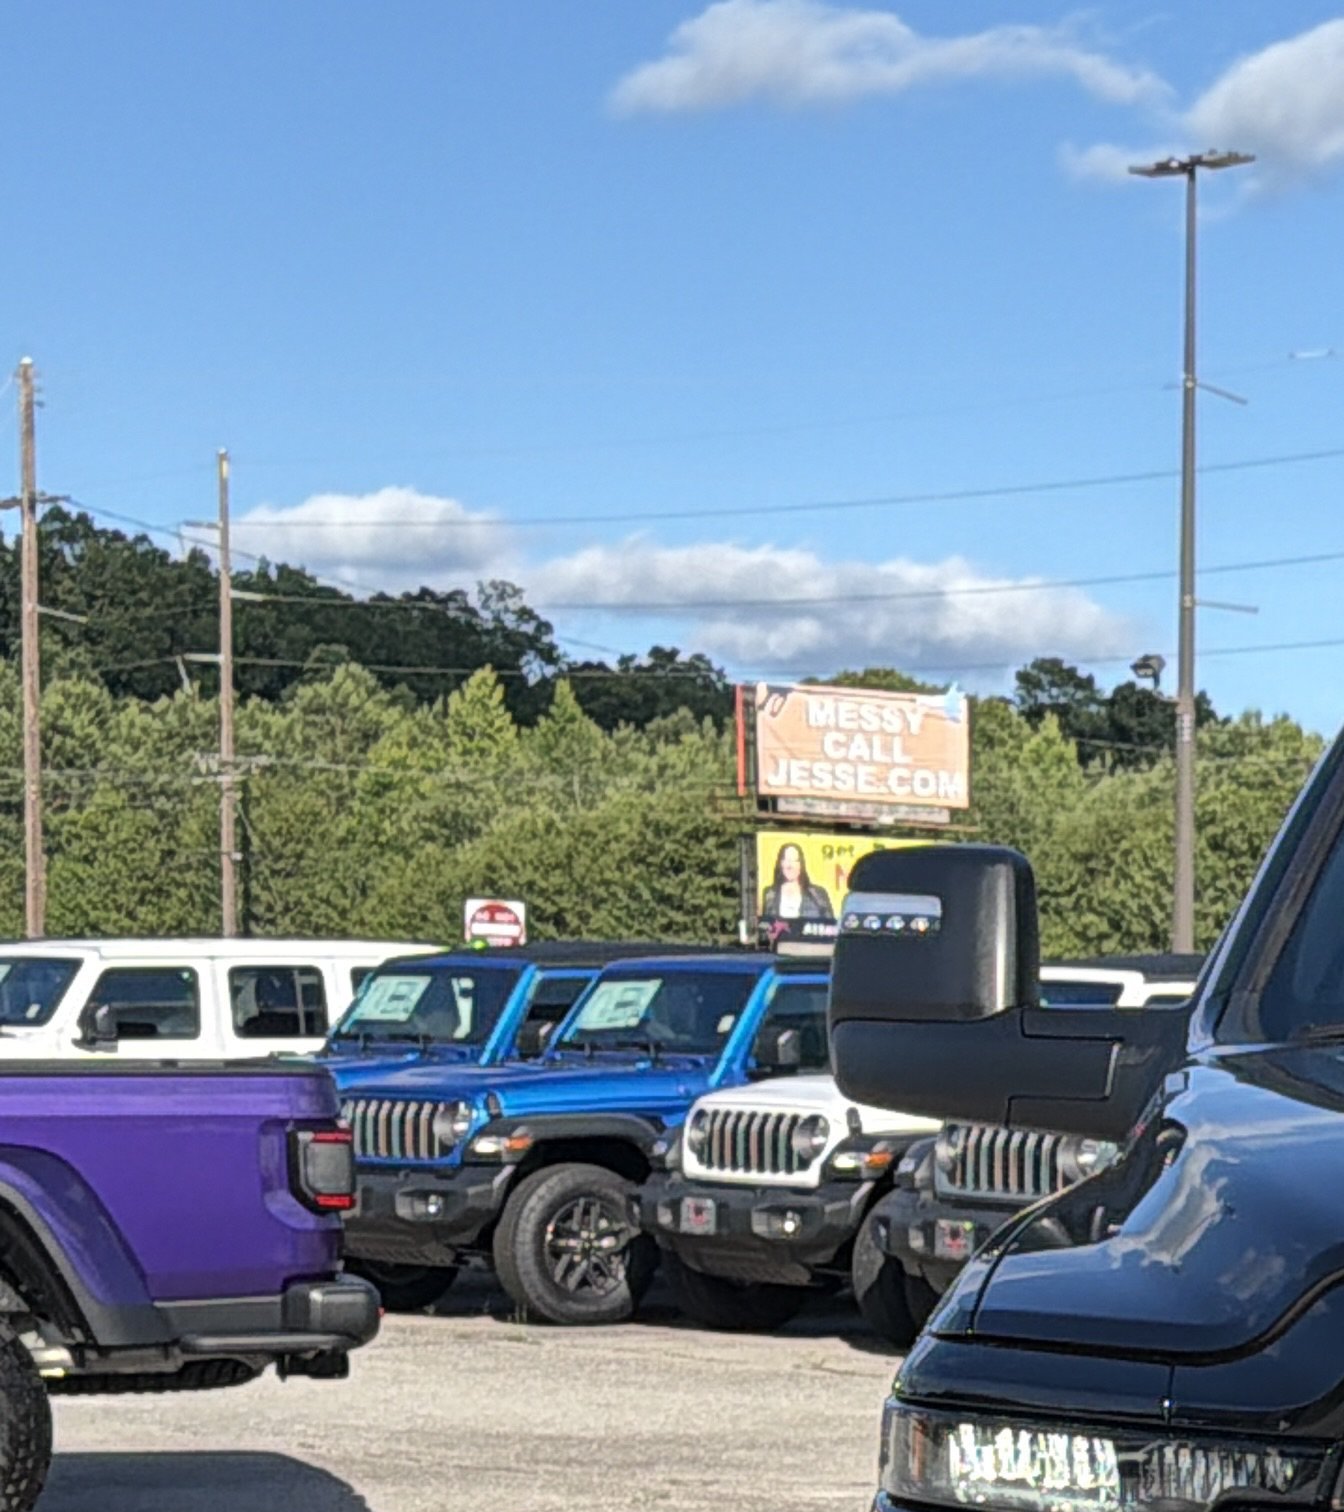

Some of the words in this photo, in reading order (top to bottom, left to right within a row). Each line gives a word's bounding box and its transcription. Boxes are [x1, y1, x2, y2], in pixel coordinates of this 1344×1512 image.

[807, 698, 925, 735] MESSY
[823, 731, 912, 764] CALL
[767, 758, 963, 799] JESSE.COM
